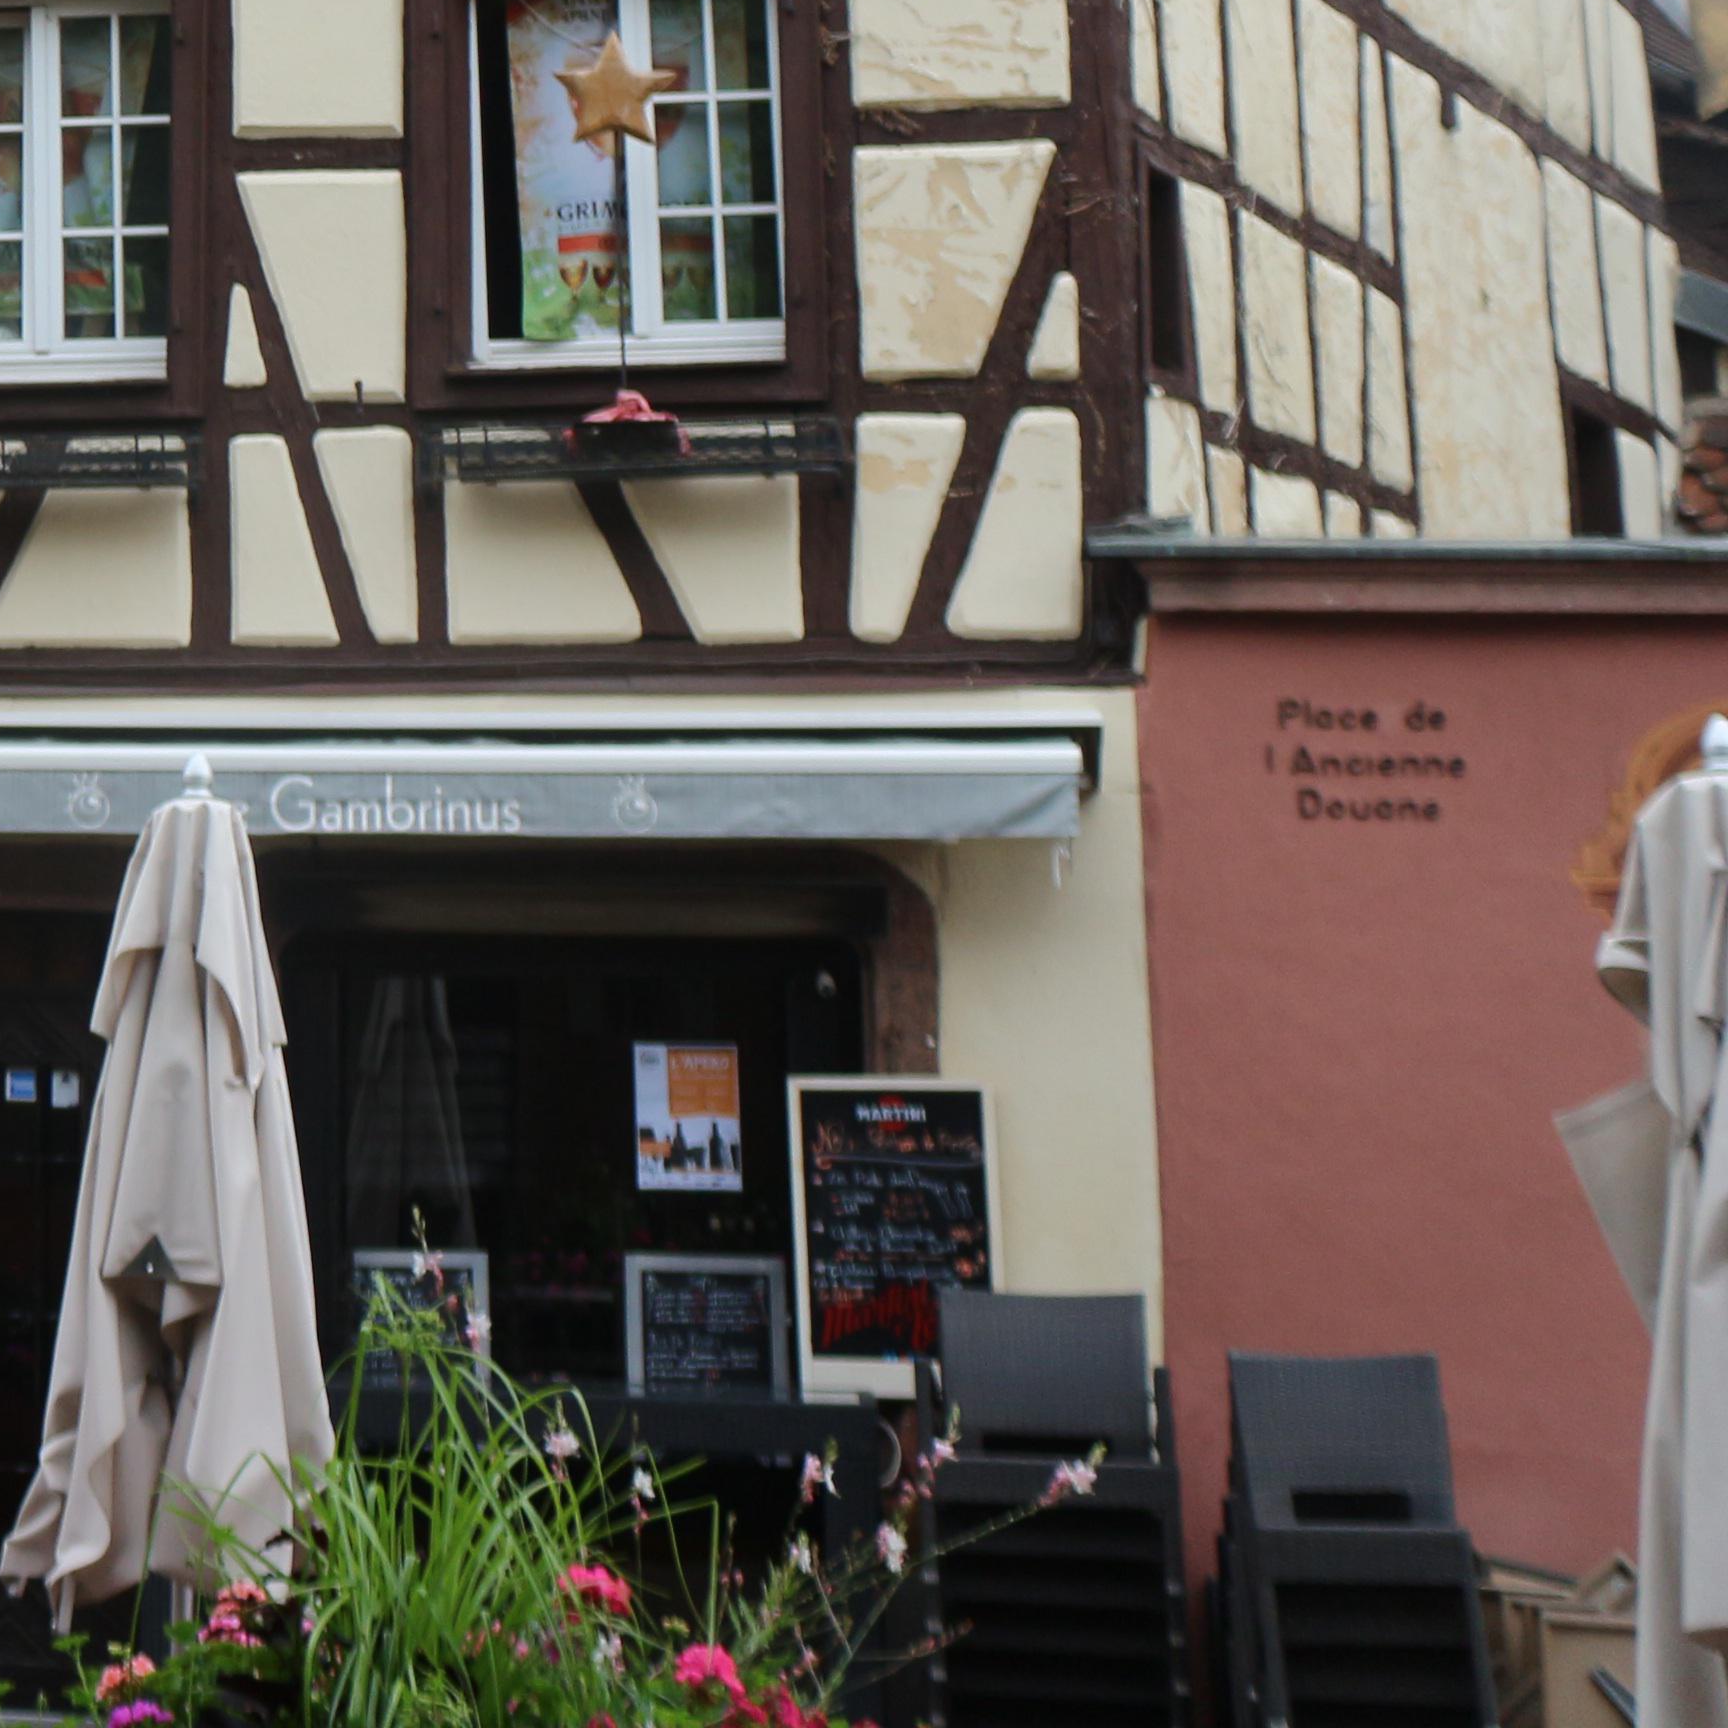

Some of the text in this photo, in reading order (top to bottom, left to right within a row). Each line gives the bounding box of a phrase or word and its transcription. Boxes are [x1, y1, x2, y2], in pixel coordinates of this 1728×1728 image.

[1277, 696, 1448, 733] Place de
[268, 773, 523, 833] Gambrinus
[1297, 786, 1441, 822] Douane
[855, 1102, 928, 1122] MARTINI
